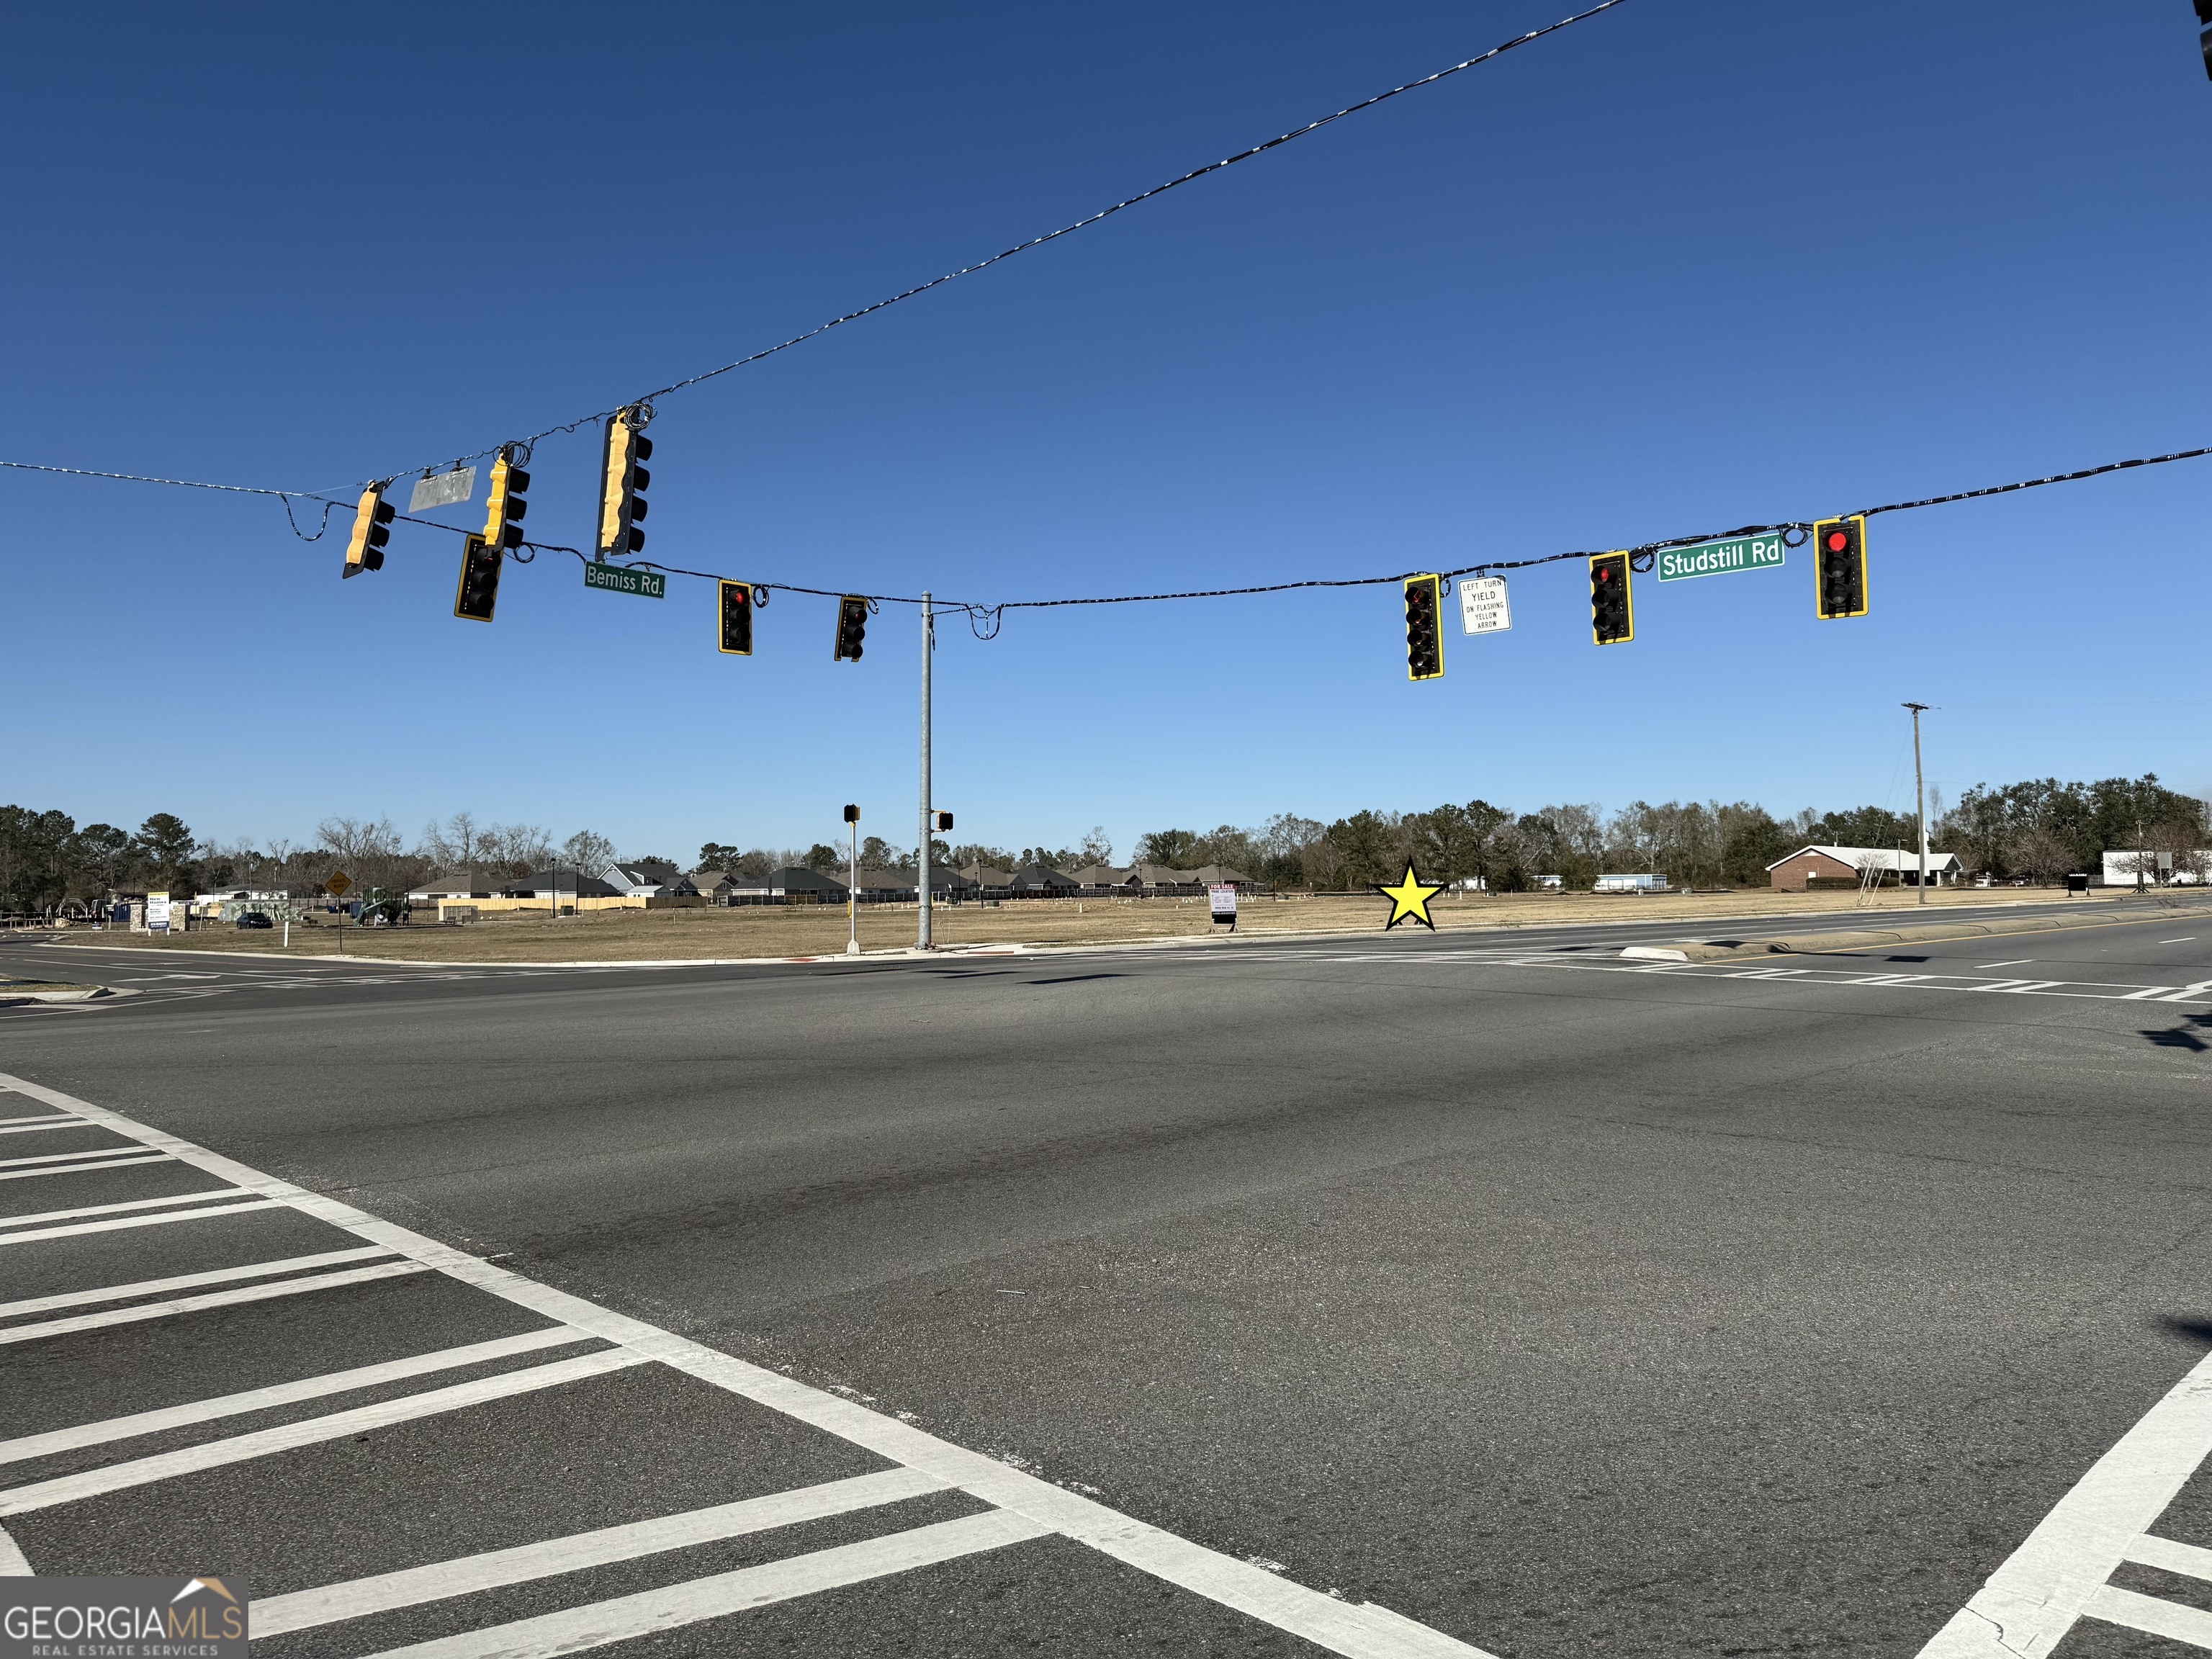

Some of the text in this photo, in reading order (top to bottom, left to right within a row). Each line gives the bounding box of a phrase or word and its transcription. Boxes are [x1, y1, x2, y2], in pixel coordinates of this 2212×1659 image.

[1663, 539, 1779, 576] Studstill Rd
[587, 566, 662, 595] Bemiss Rd.
[1462, 580, 1502, 591] LEFT TURN
[1471, 590, 1496, 601] YIELD
[1477, 601, 1504, 611] FLASHING
[1475, 611, 1497, 621] YELLOW
[1478, 621, 1497, 629] ARROW
